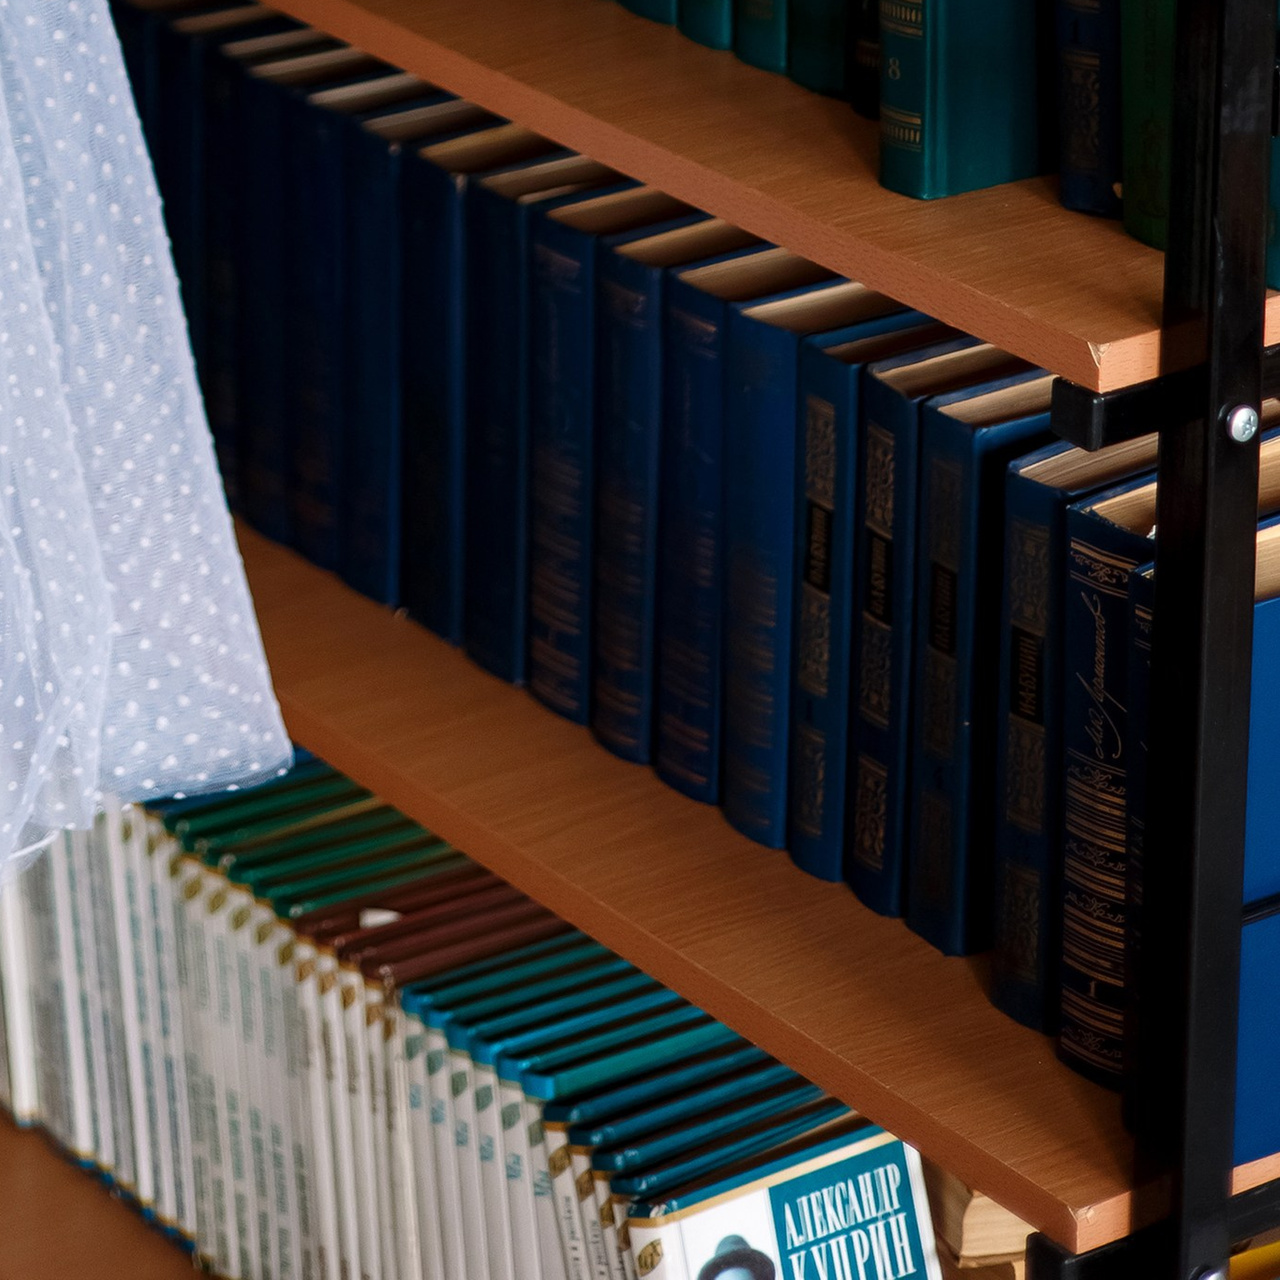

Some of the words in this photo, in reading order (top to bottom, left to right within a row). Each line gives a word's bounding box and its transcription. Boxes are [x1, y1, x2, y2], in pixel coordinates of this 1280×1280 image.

[1068, 17, 1081, 44] 1
[887, 56, 901, 81] 8
[783, 1162, 902, 1251] АЛЕКСАНДР
